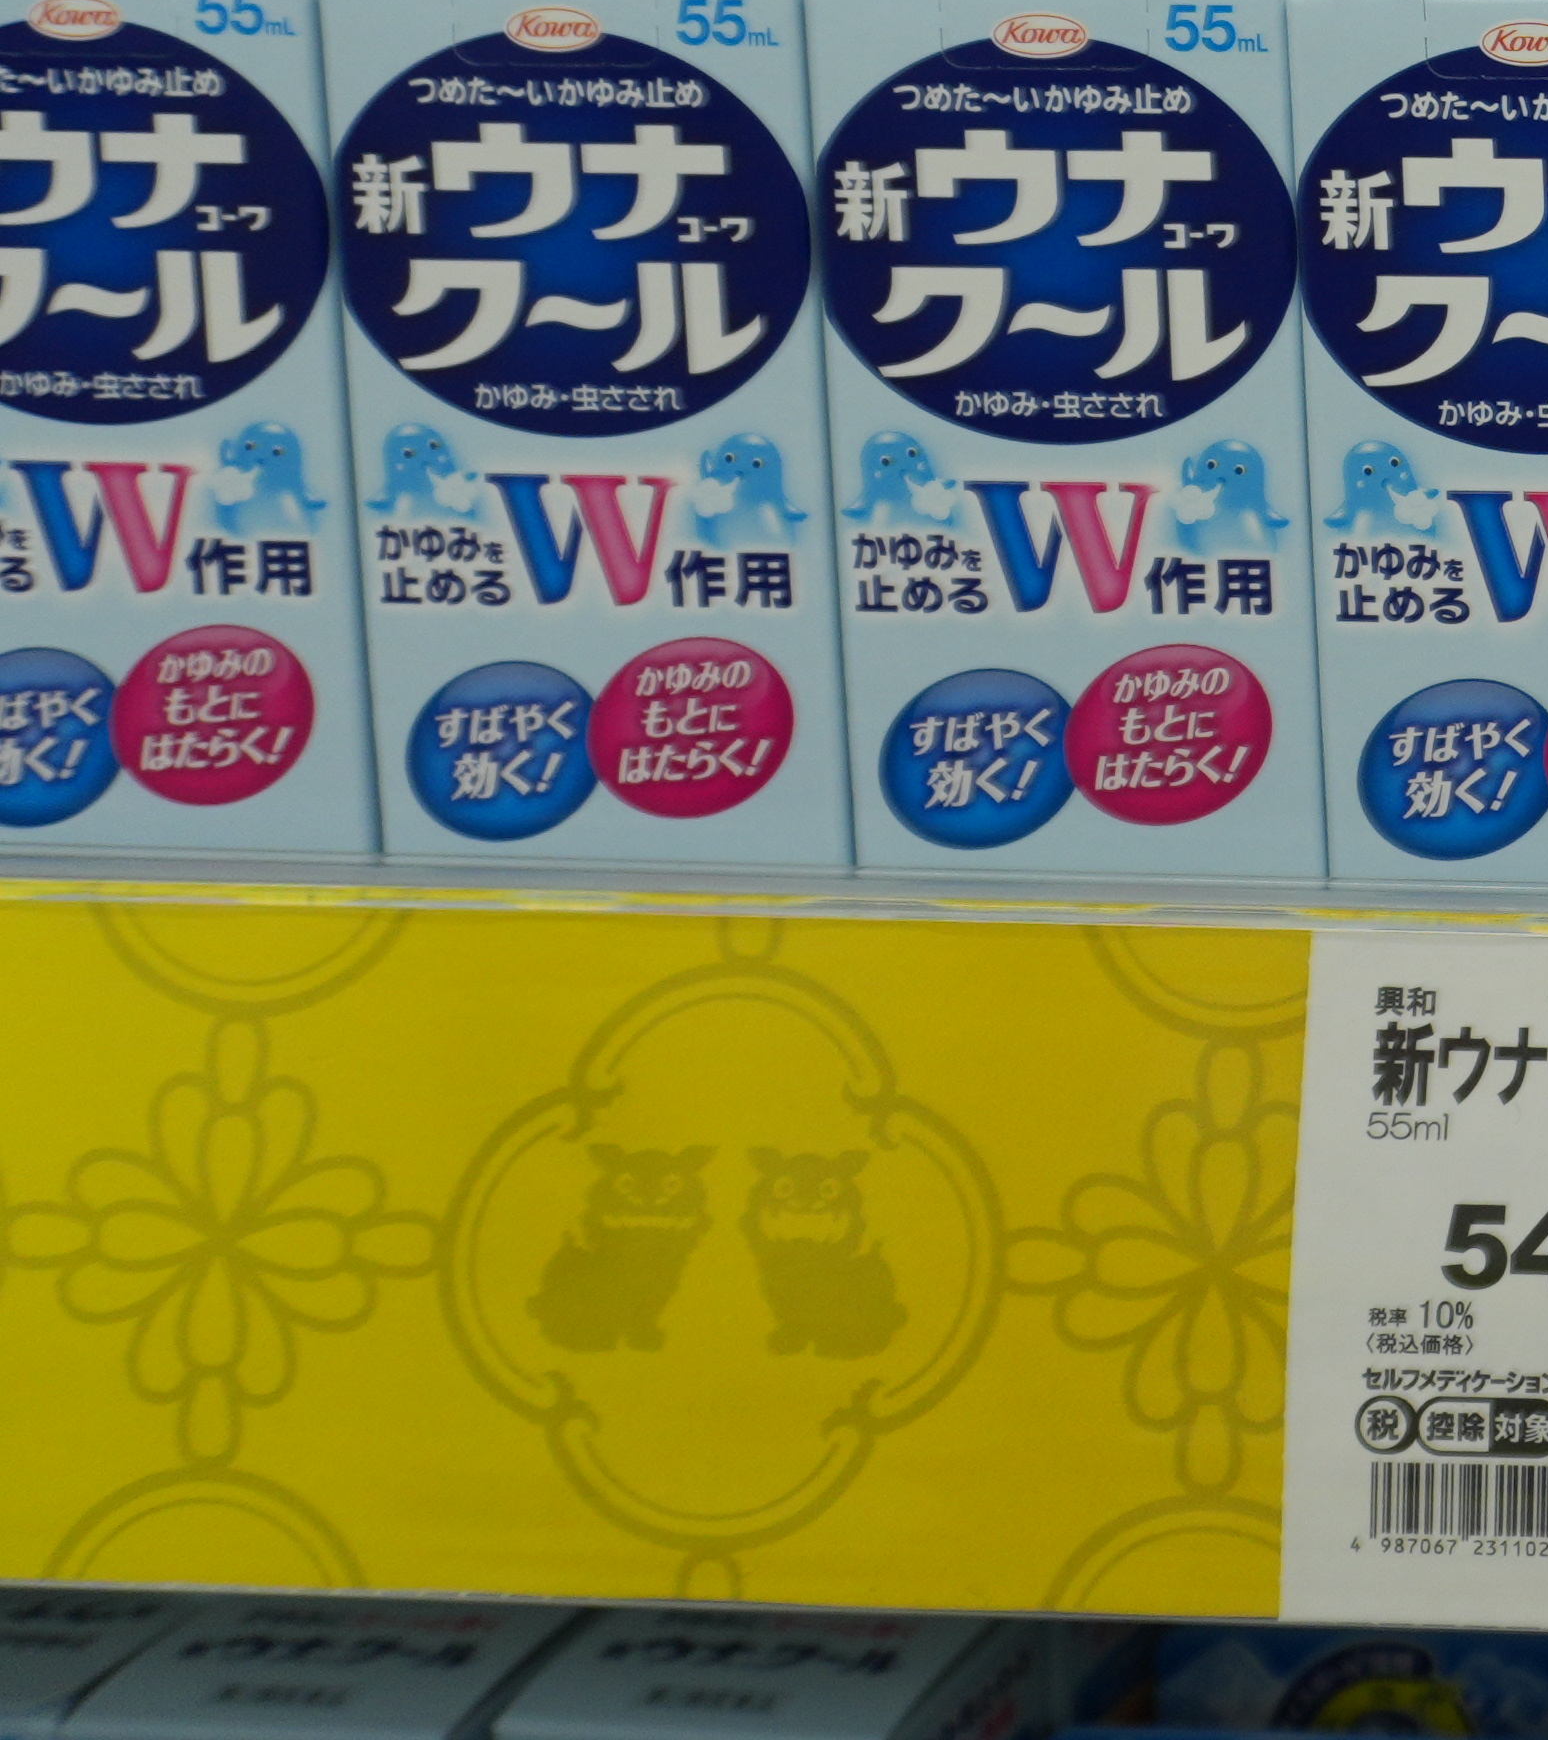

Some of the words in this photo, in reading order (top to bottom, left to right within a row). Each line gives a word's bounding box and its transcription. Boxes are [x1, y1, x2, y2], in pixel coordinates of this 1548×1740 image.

[31, 2, 117, 30] Kowa
[675, 0, 778, 46] 55mL
[1375, 987, 1437, 1017] 興和
[1367, 1112, 1450, 1141] 55ml
[1381, 1538, 1457, 1554] 987067
